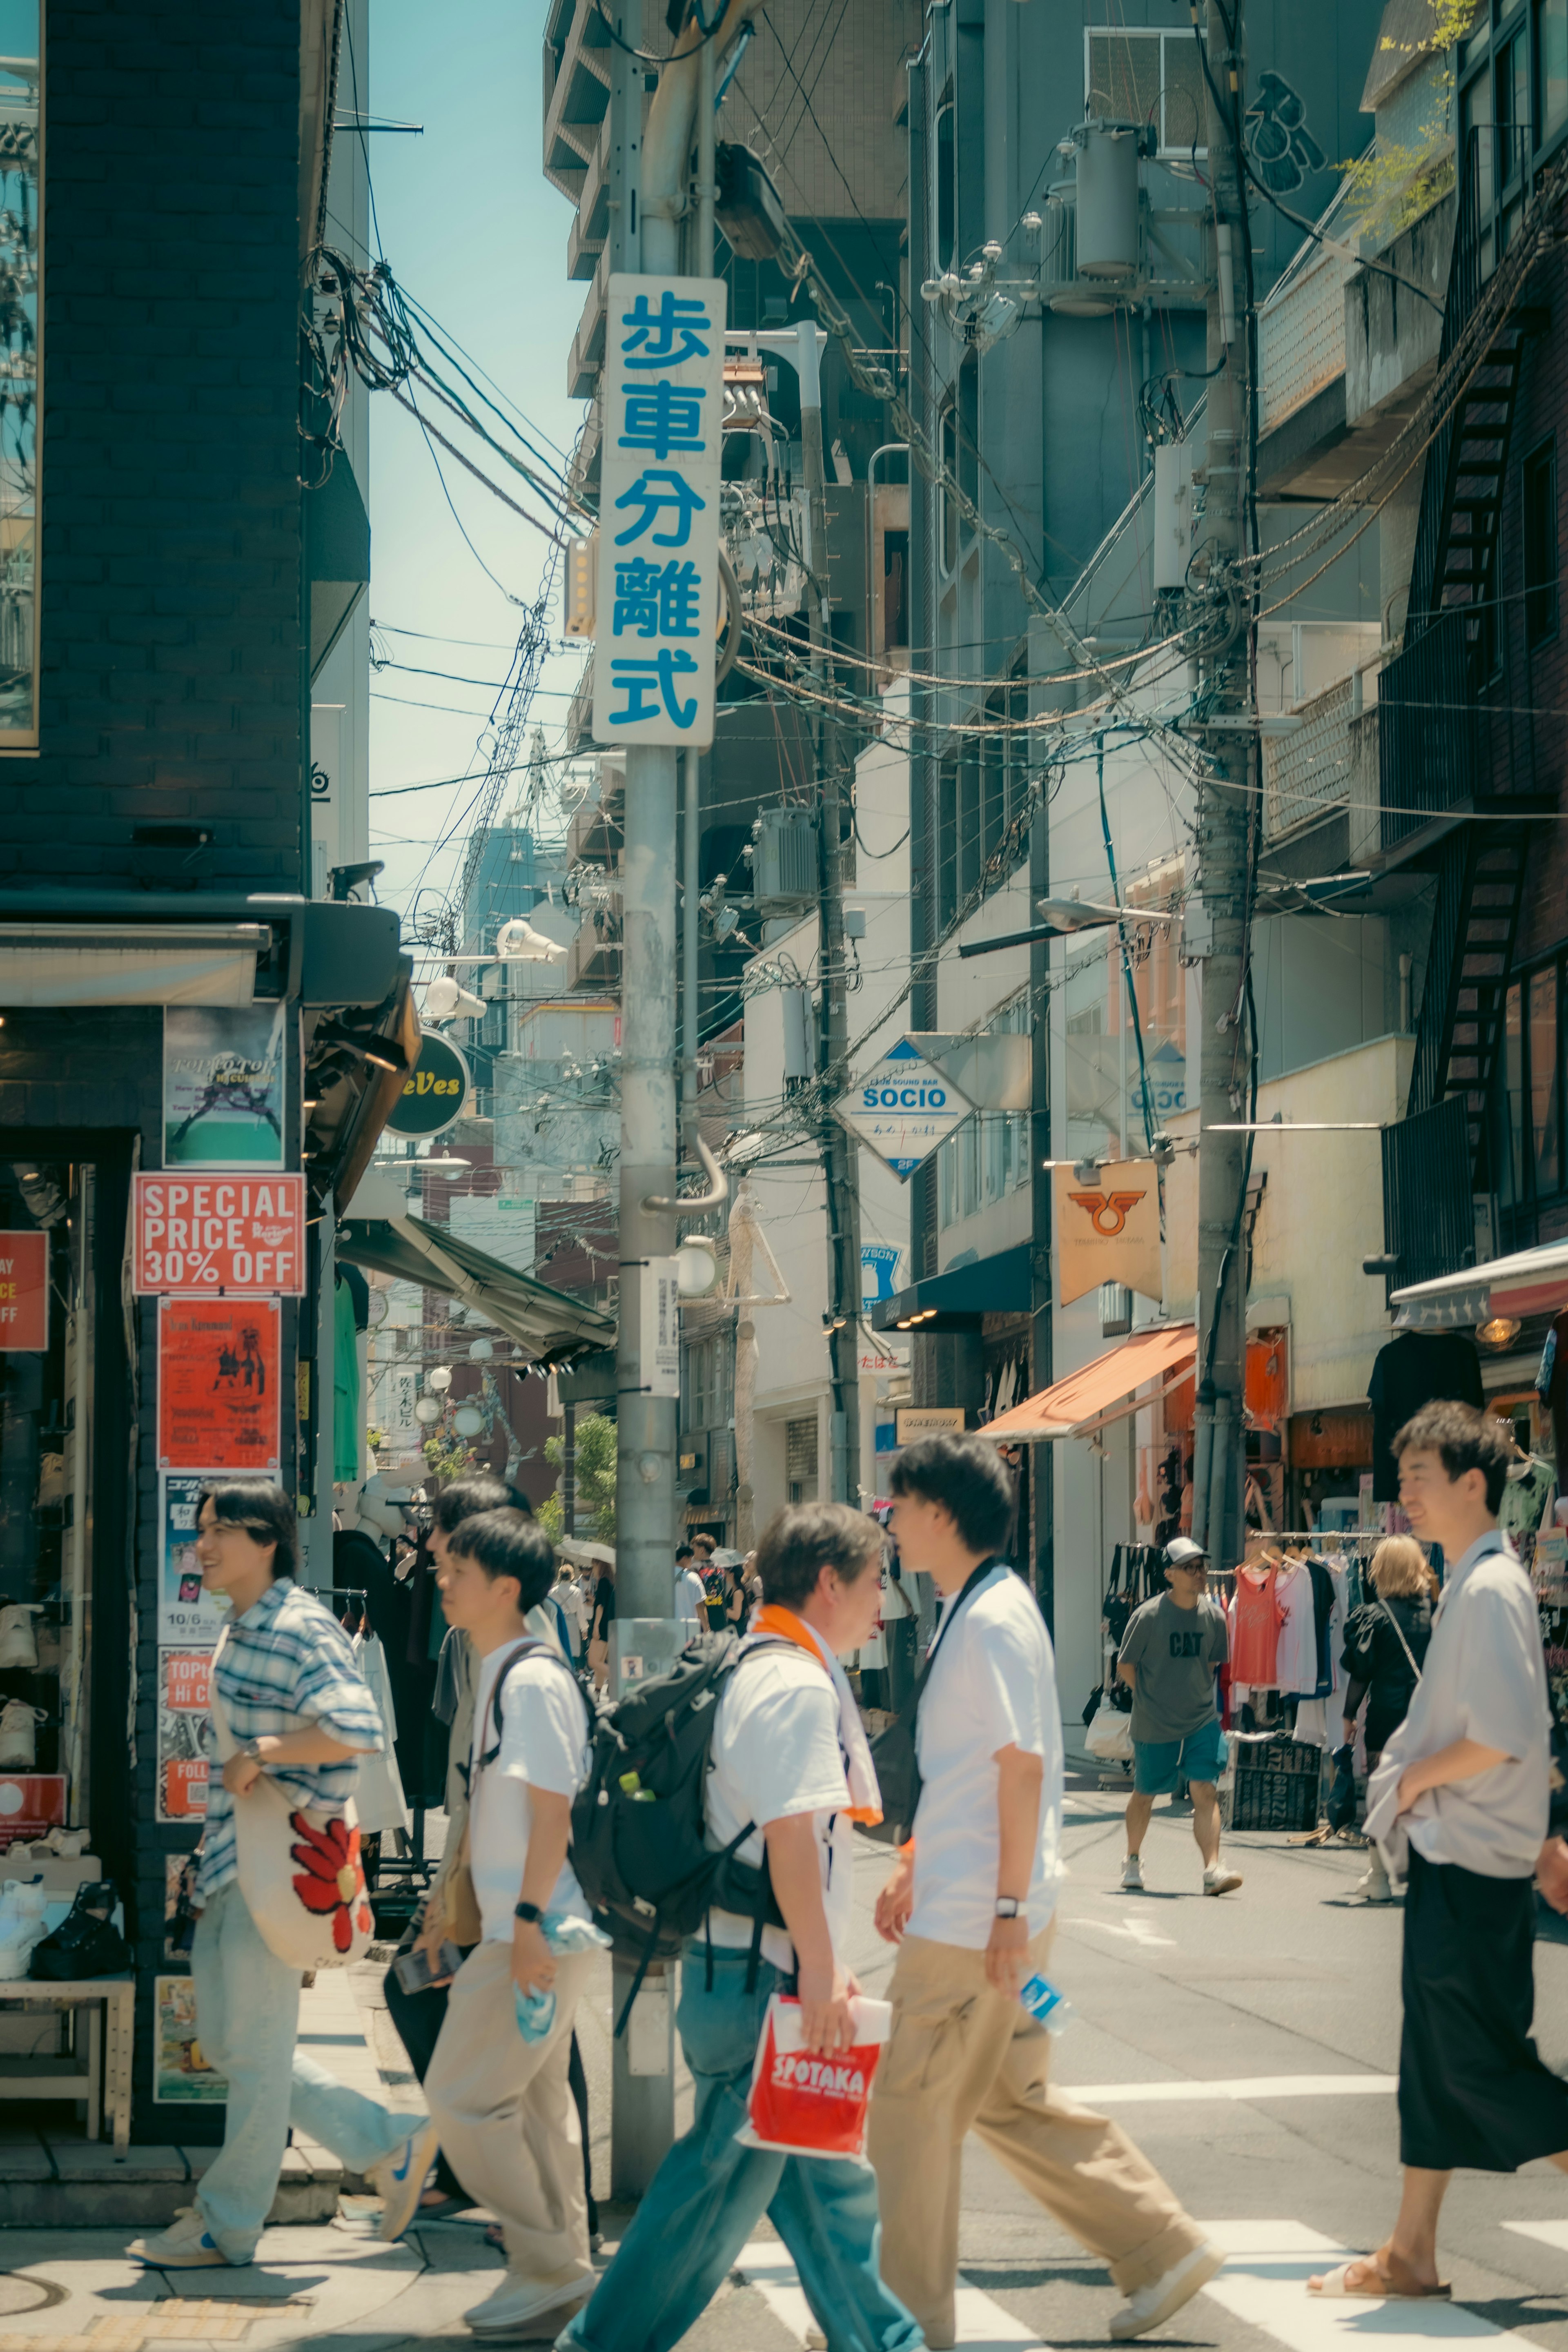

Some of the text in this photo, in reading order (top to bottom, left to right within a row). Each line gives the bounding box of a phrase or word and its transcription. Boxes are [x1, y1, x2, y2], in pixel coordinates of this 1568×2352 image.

[608, 291, 711, 729] 歩車分離式
[863, 1088, 946, 1108] SOCIO
[898, 1160, 913, 1170] 2F
[145, 1185, 294, 1217] SPECIAL
[145, 1218, 245, 1250] PRICE
[145, 1250, 294, 1283] 30% OFF
[167, 1614, 200, 1624] 10/6
[1169, 1632, 1204, 1657] CAT
[176, 1685, 190, 1702] Hi
[774, 2055, 864, 2094] SPOTAKA
